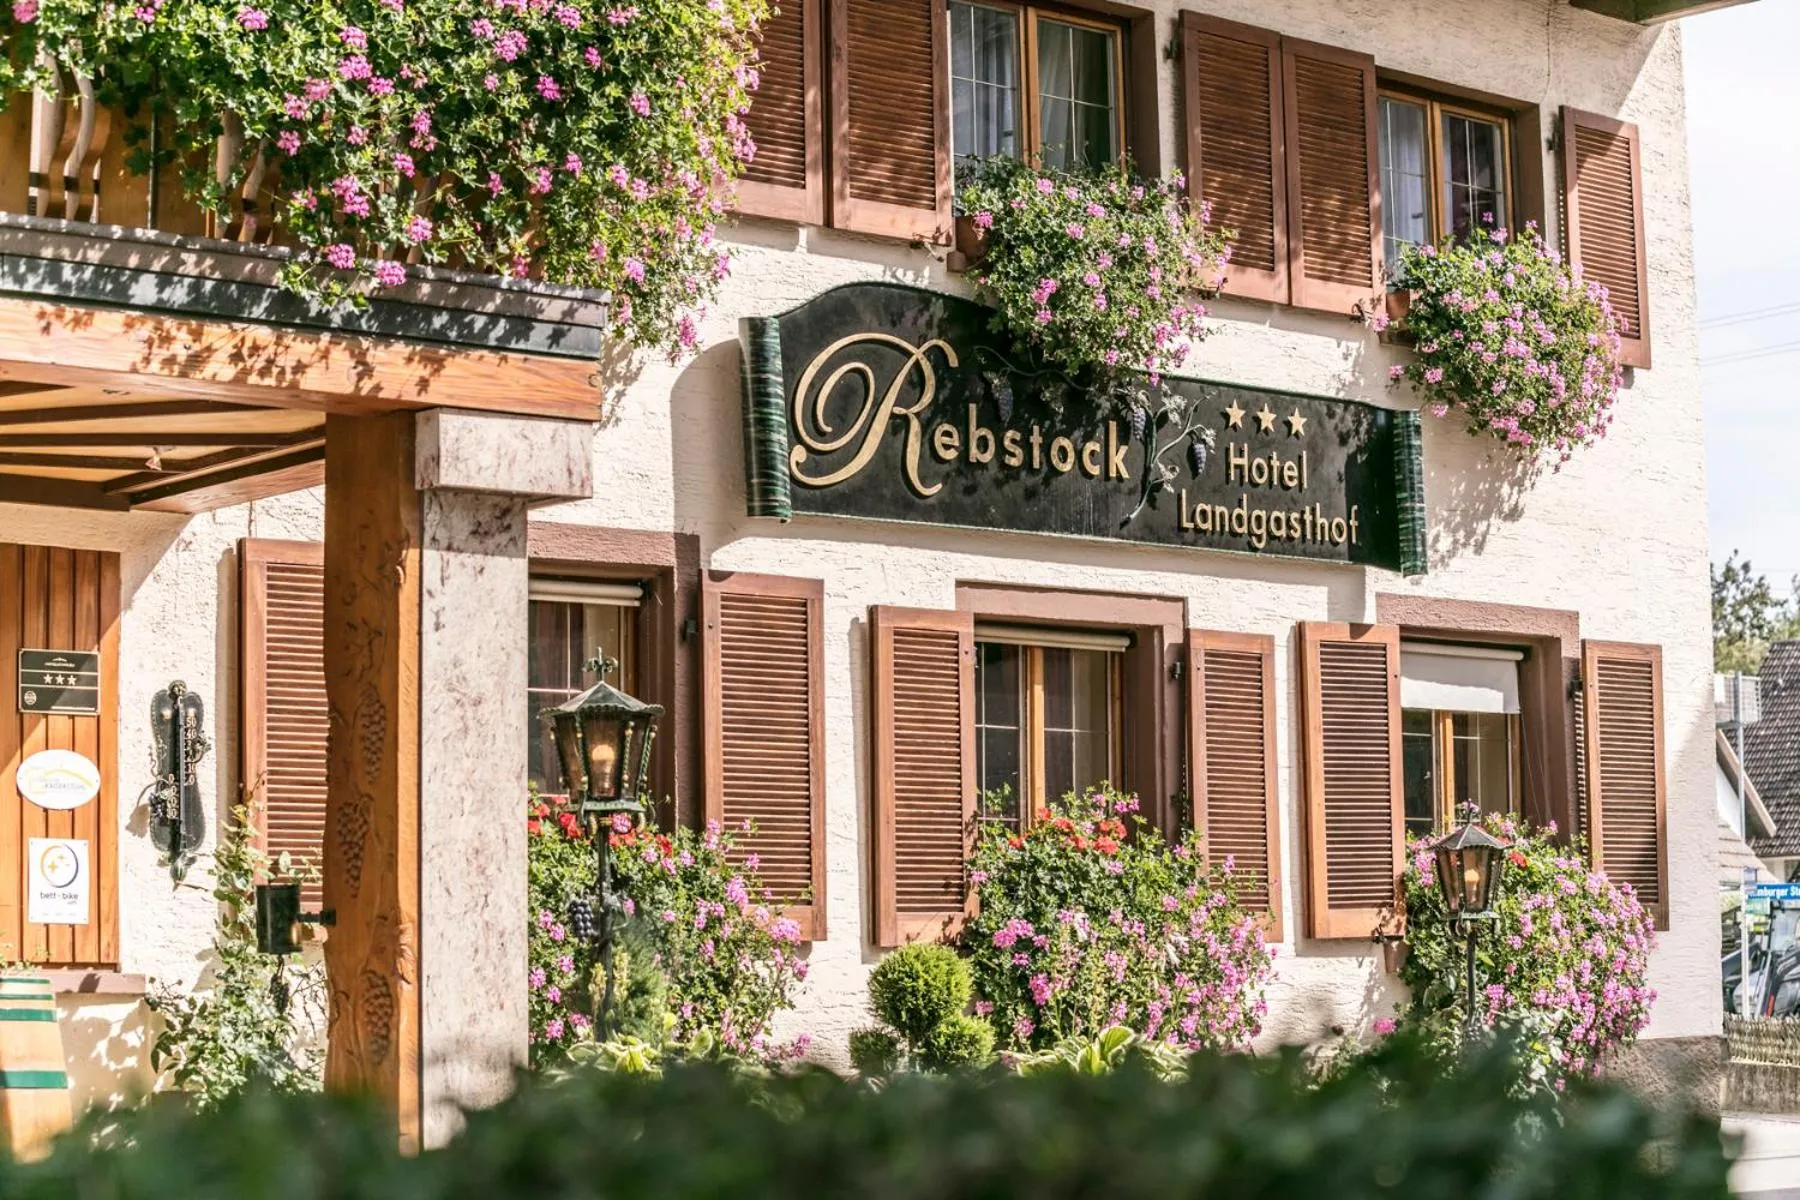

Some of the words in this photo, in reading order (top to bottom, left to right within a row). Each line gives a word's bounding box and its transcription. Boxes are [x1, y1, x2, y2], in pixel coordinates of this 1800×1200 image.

[789, 332, 1130, 496] Rebstock
[1229, 442, 1308, 489] Hotel
[1181, 488, 1359, 549] Landgasthof
